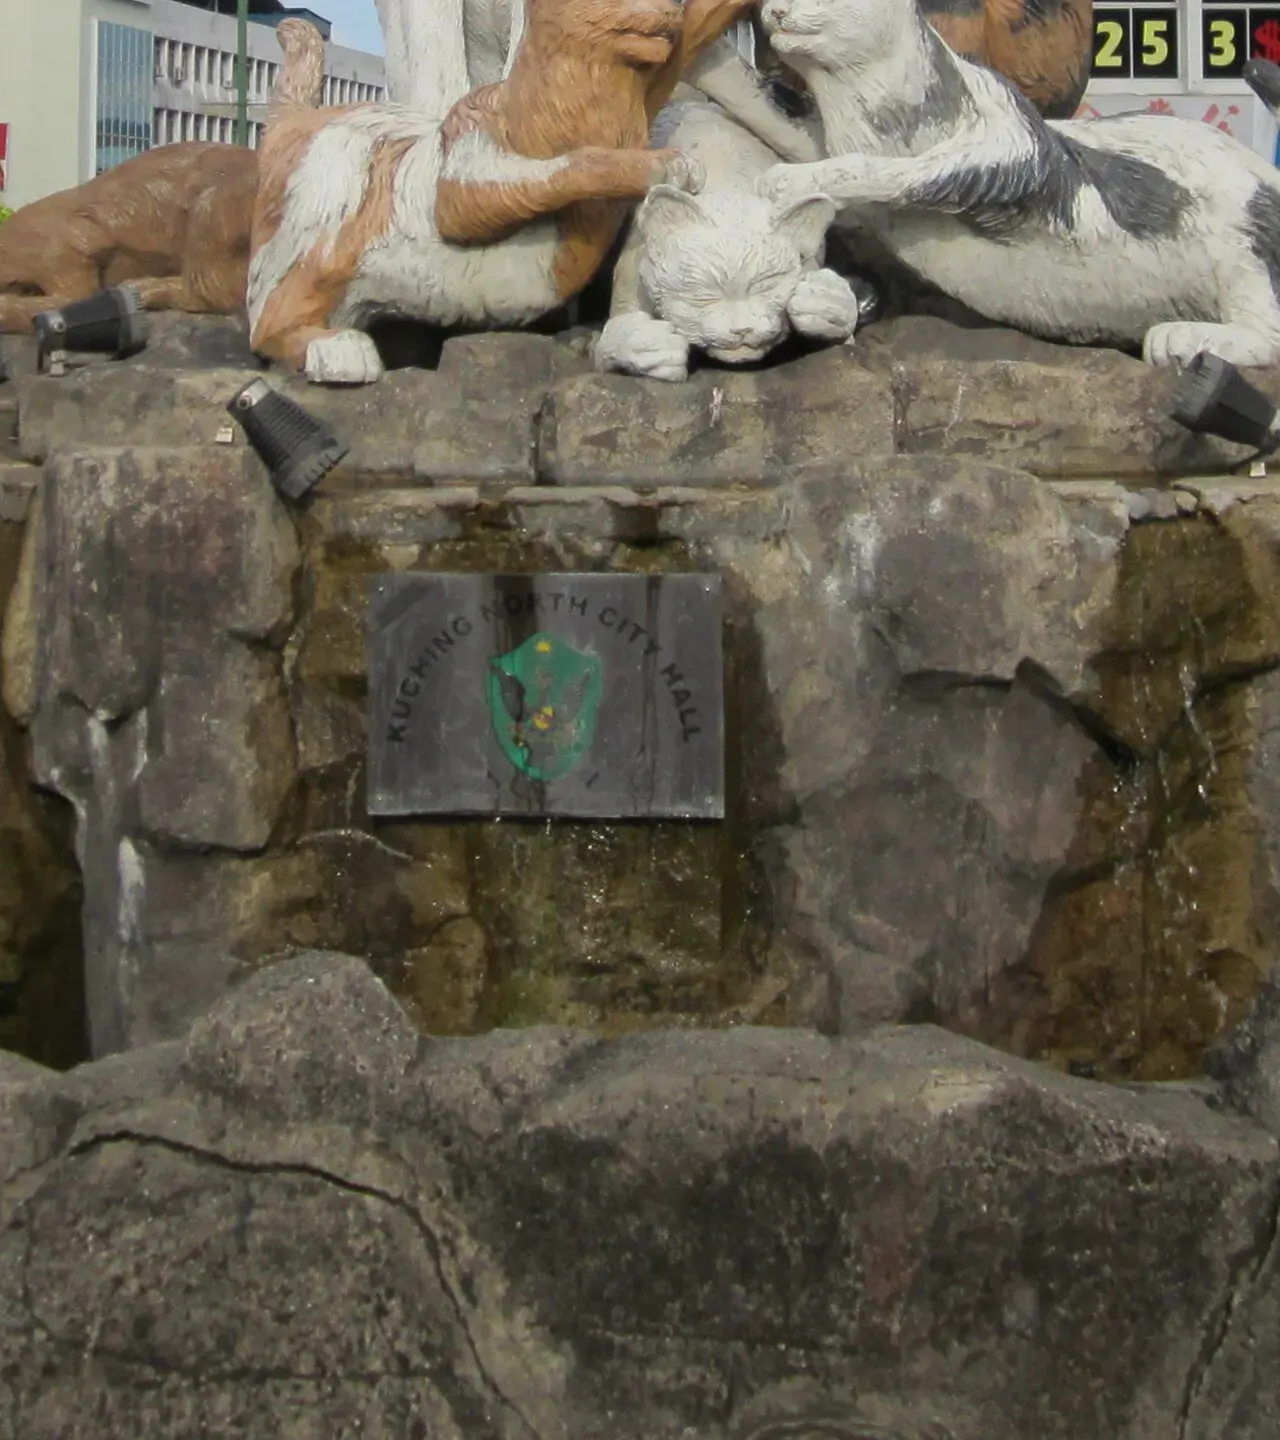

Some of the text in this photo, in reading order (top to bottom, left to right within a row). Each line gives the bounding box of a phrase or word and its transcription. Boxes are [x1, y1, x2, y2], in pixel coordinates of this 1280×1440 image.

[386, 592, 701, 744] KUCHING NORTH CITY HALL
